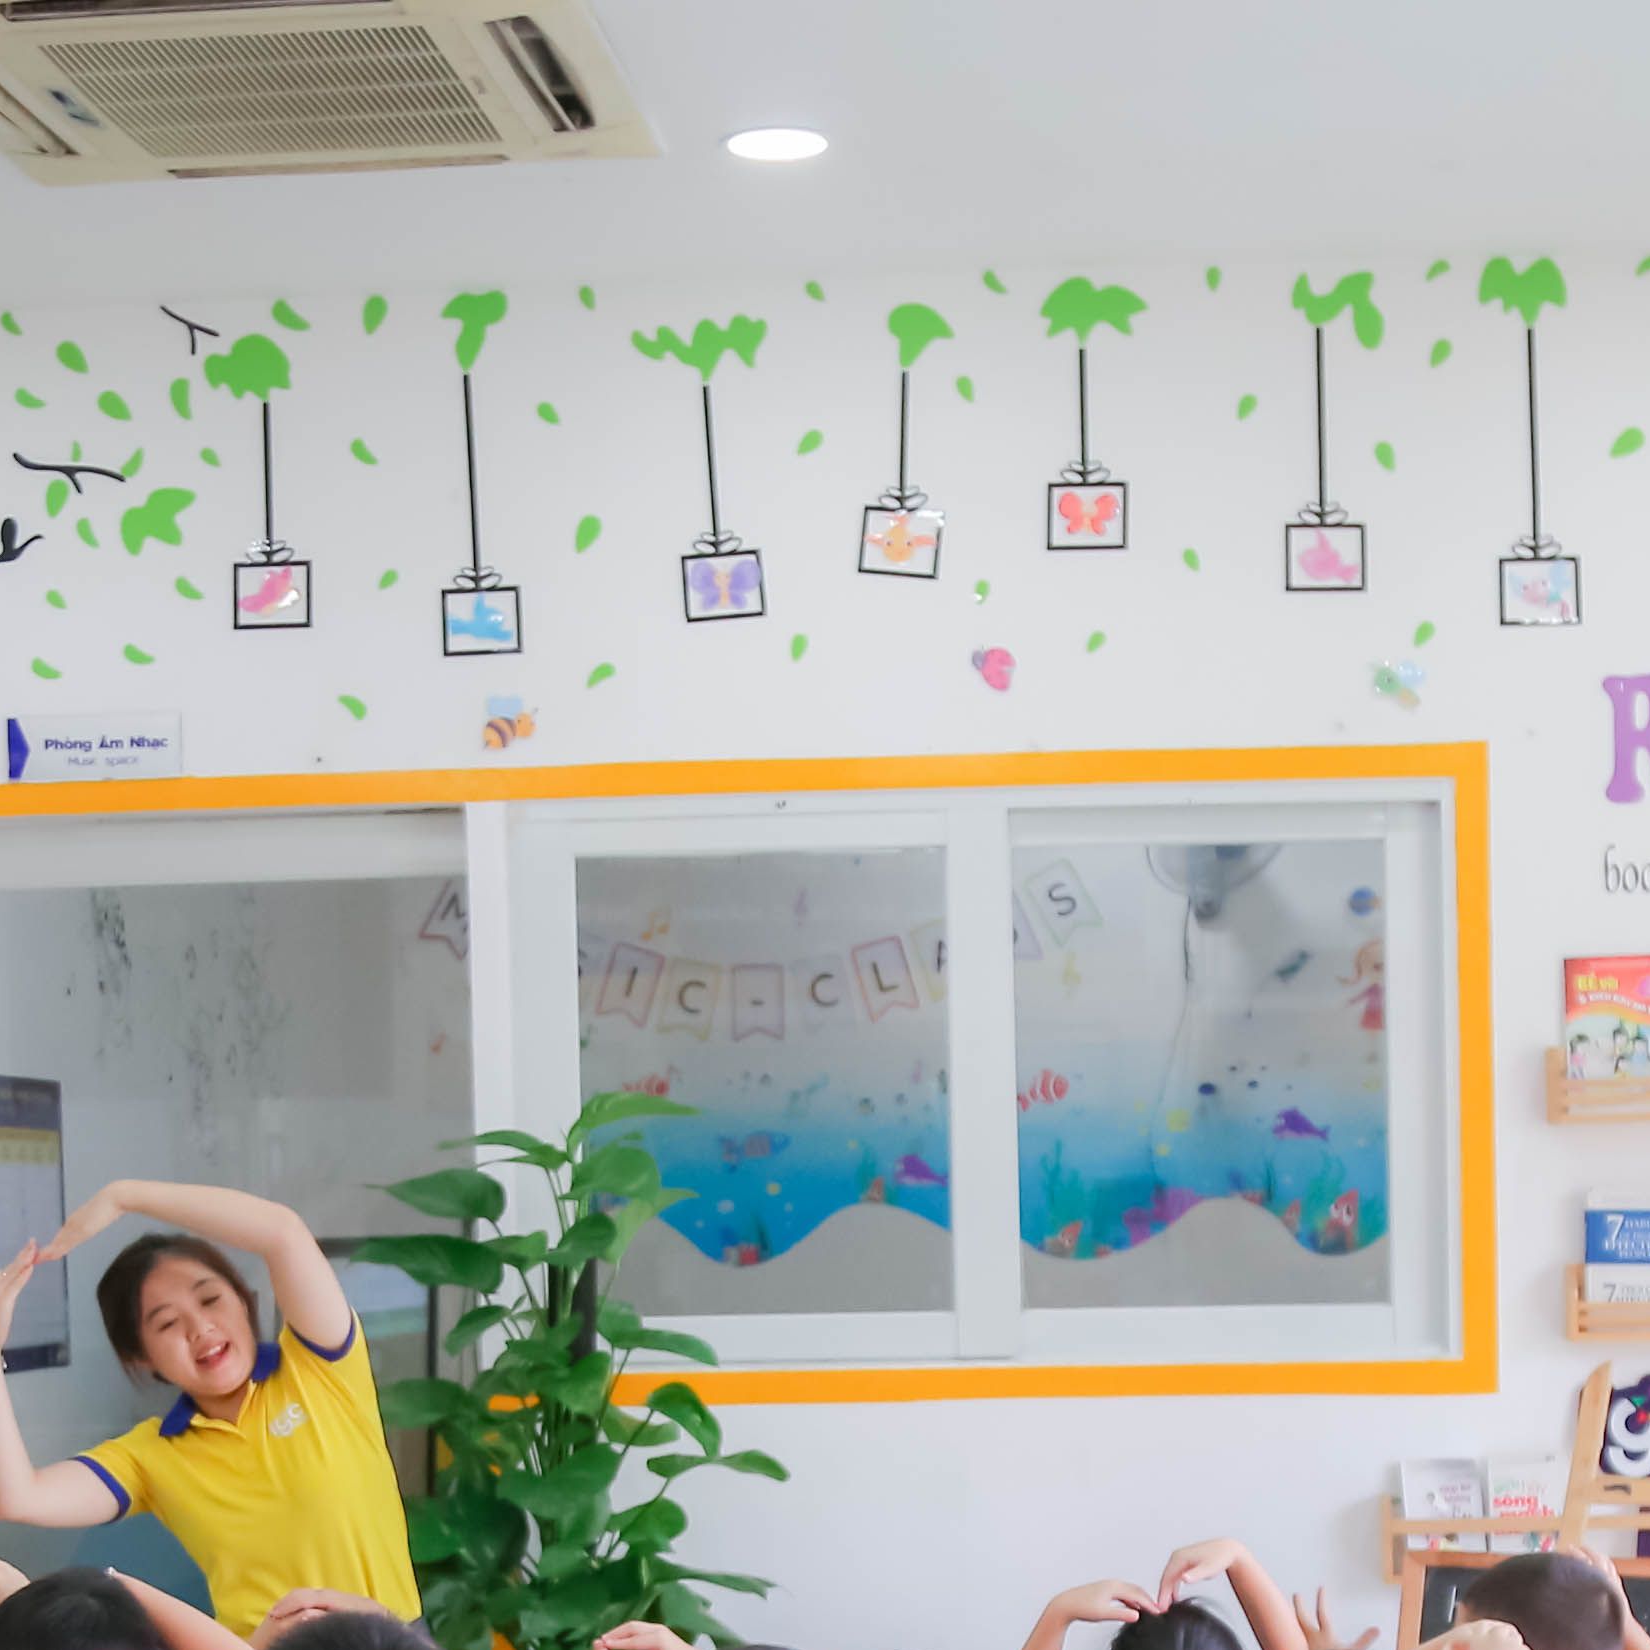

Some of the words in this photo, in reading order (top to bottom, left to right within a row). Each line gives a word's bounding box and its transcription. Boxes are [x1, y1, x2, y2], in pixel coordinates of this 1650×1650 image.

[44, 737, 93, 752] Phòng
[130, 736, 169, 751] Nhạc
[1606, 1214, 1625, 1243] 7
